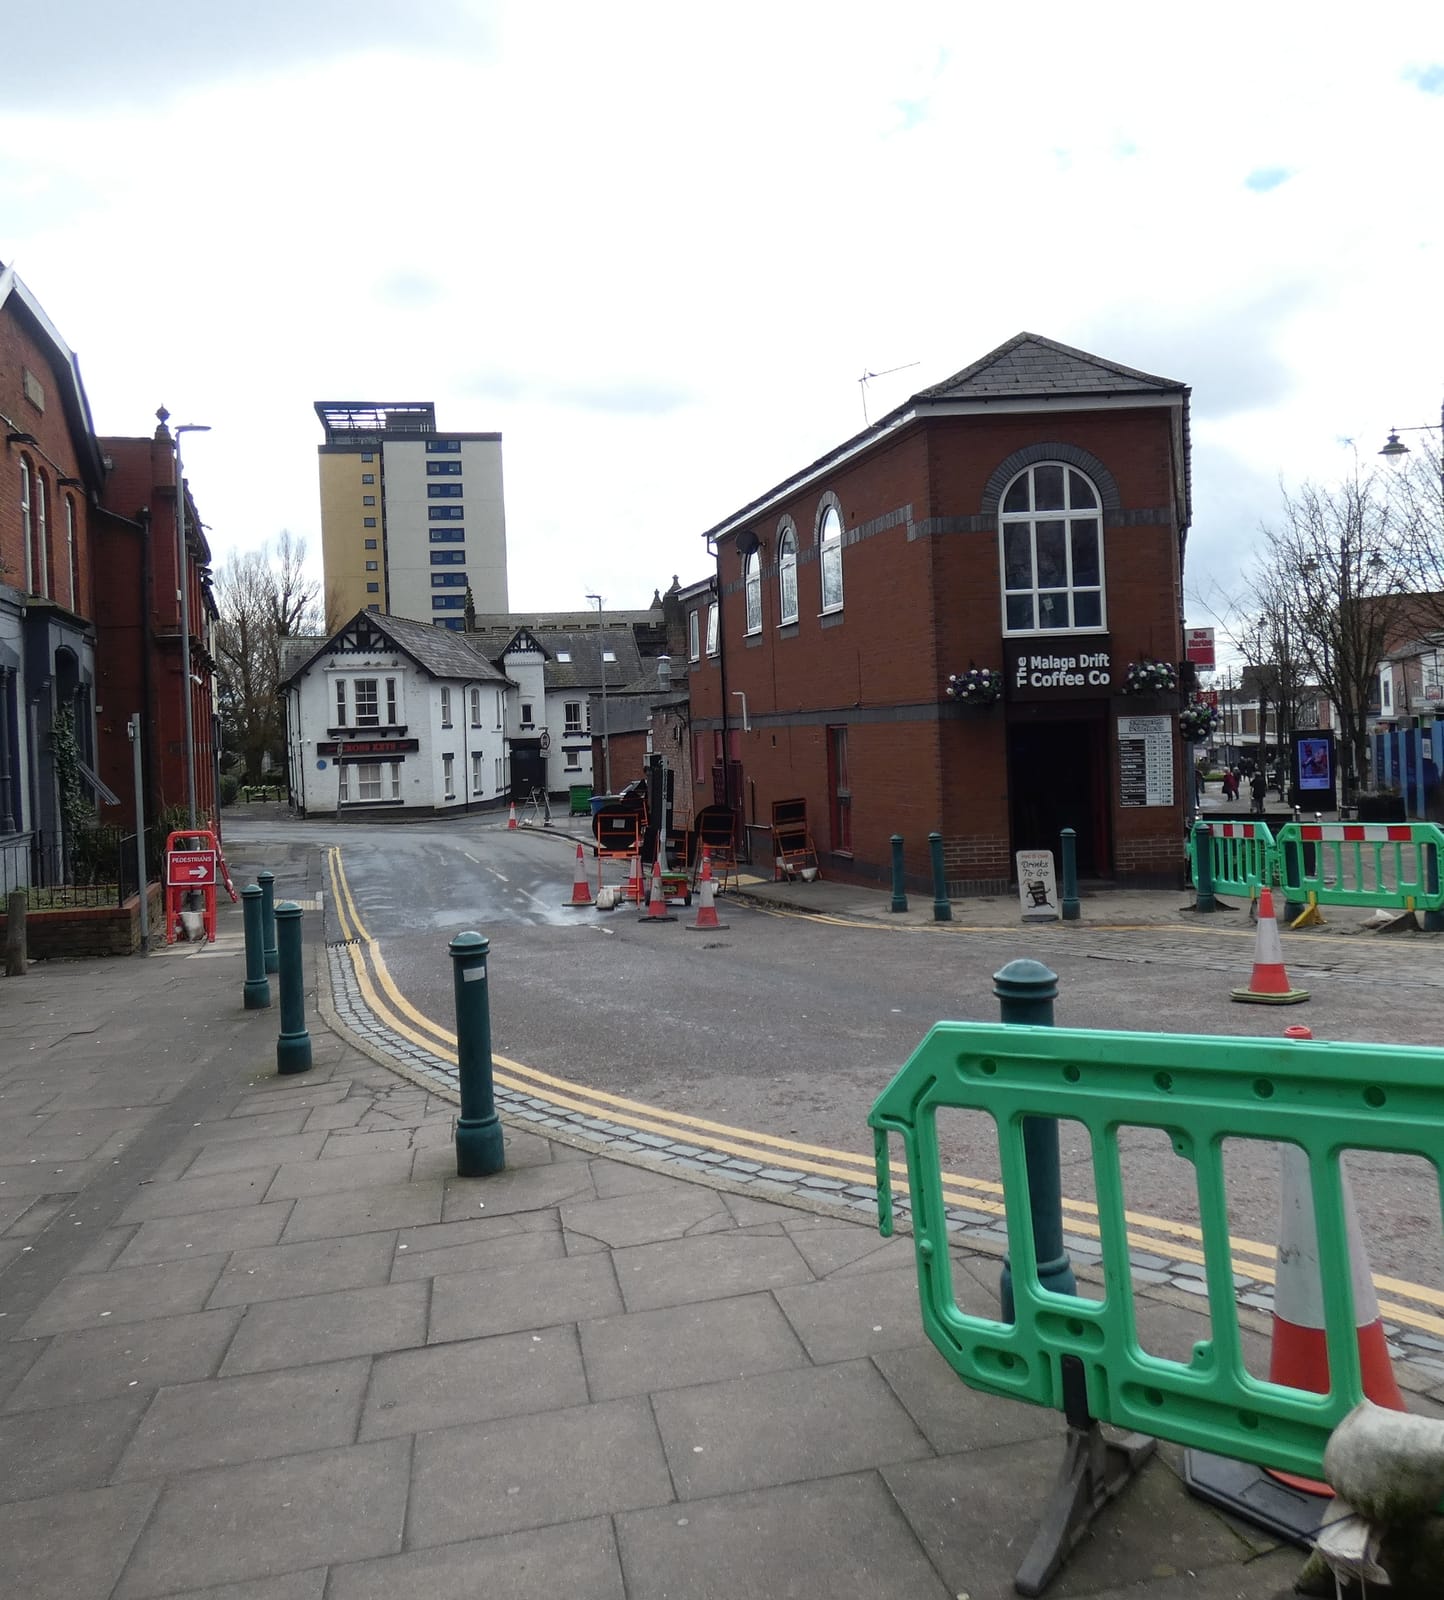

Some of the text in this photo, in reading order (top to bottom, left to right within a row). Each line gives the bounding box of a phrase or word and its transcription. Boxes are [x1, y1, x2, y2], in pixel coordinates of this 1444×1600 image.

[1030, 652, 1110, 671] Malaga Drift
[1016, 656, 1027, 688] The
[1030, 670, 1110, 687] Coffee Co
